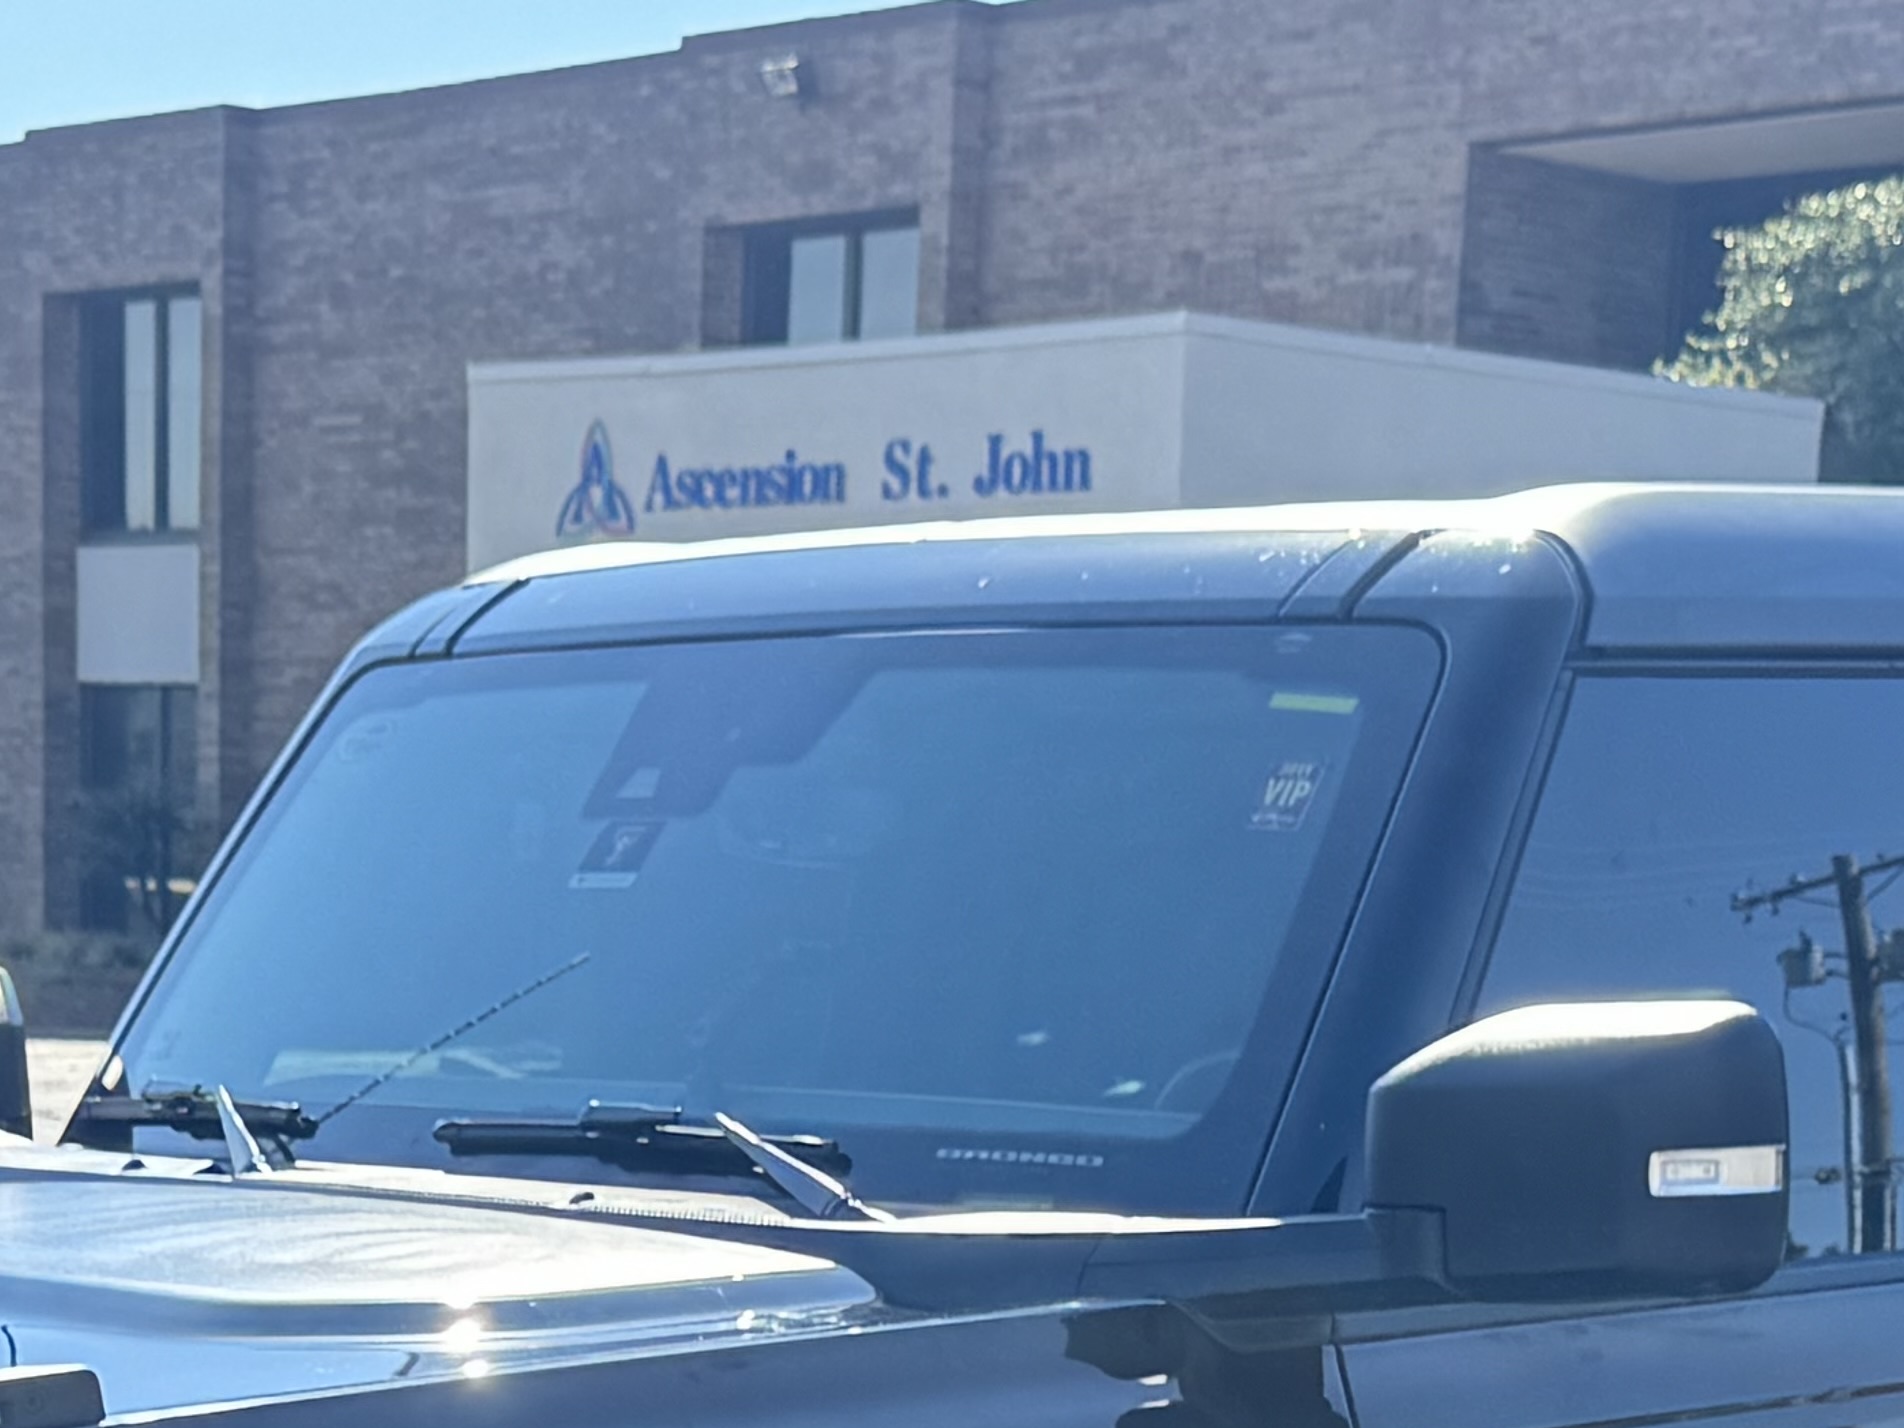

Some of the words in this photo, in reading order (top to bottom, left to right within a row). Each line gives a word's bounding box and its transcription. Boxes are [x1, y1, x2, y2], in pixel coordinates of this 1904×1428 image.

[644, 450, 846, 512] Ascension
[882, 438, 949, 500] St.
[973, 429, 1092, 498] John
[1264, 777, 1311, 806] VIP
